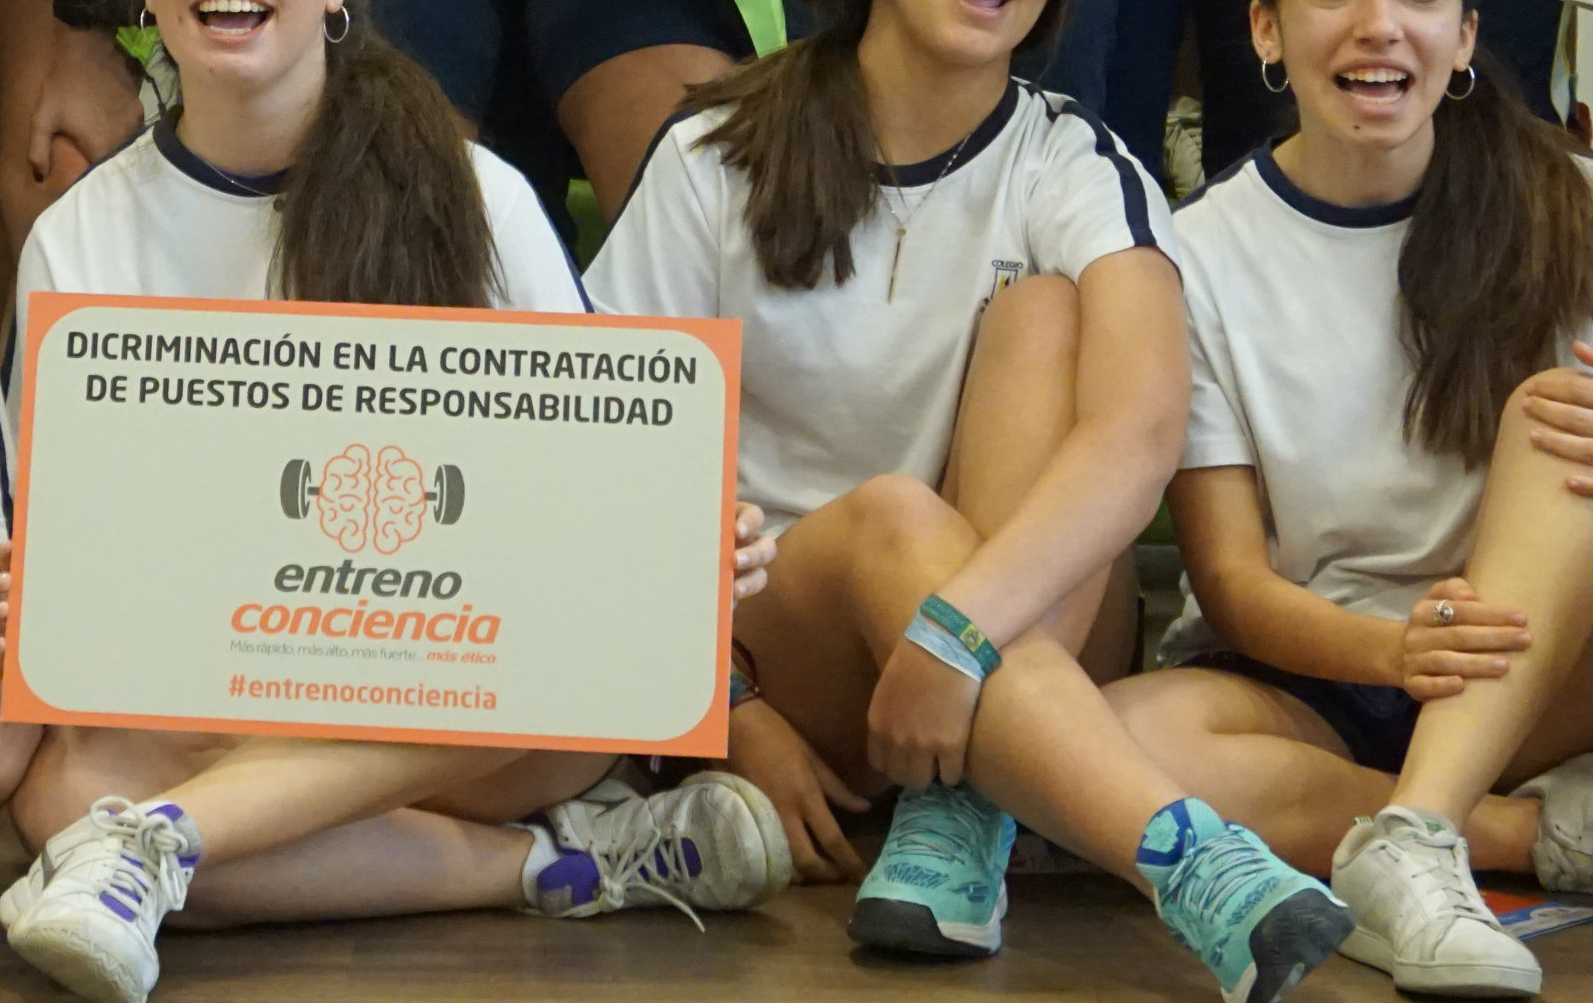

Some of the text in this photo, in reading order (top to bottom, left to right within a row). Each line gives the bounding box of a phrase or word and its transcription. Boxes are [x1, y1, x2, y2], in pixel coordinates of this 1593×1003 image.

[66, 331, 697, 385] DICRIMINACIÓN EN LA CONTRATACIÓN
[85, 374, 674, 427] DE PUESTOS DE RESPONSABILIDAD
[273, 559, 463, 600] entreno
[230, 599, 502, 645] conciencia
[426, 649, 457, 663] más
[460, 651, 497, 664] ético
[228, 674, 497, 710] #entrenoconciencia
